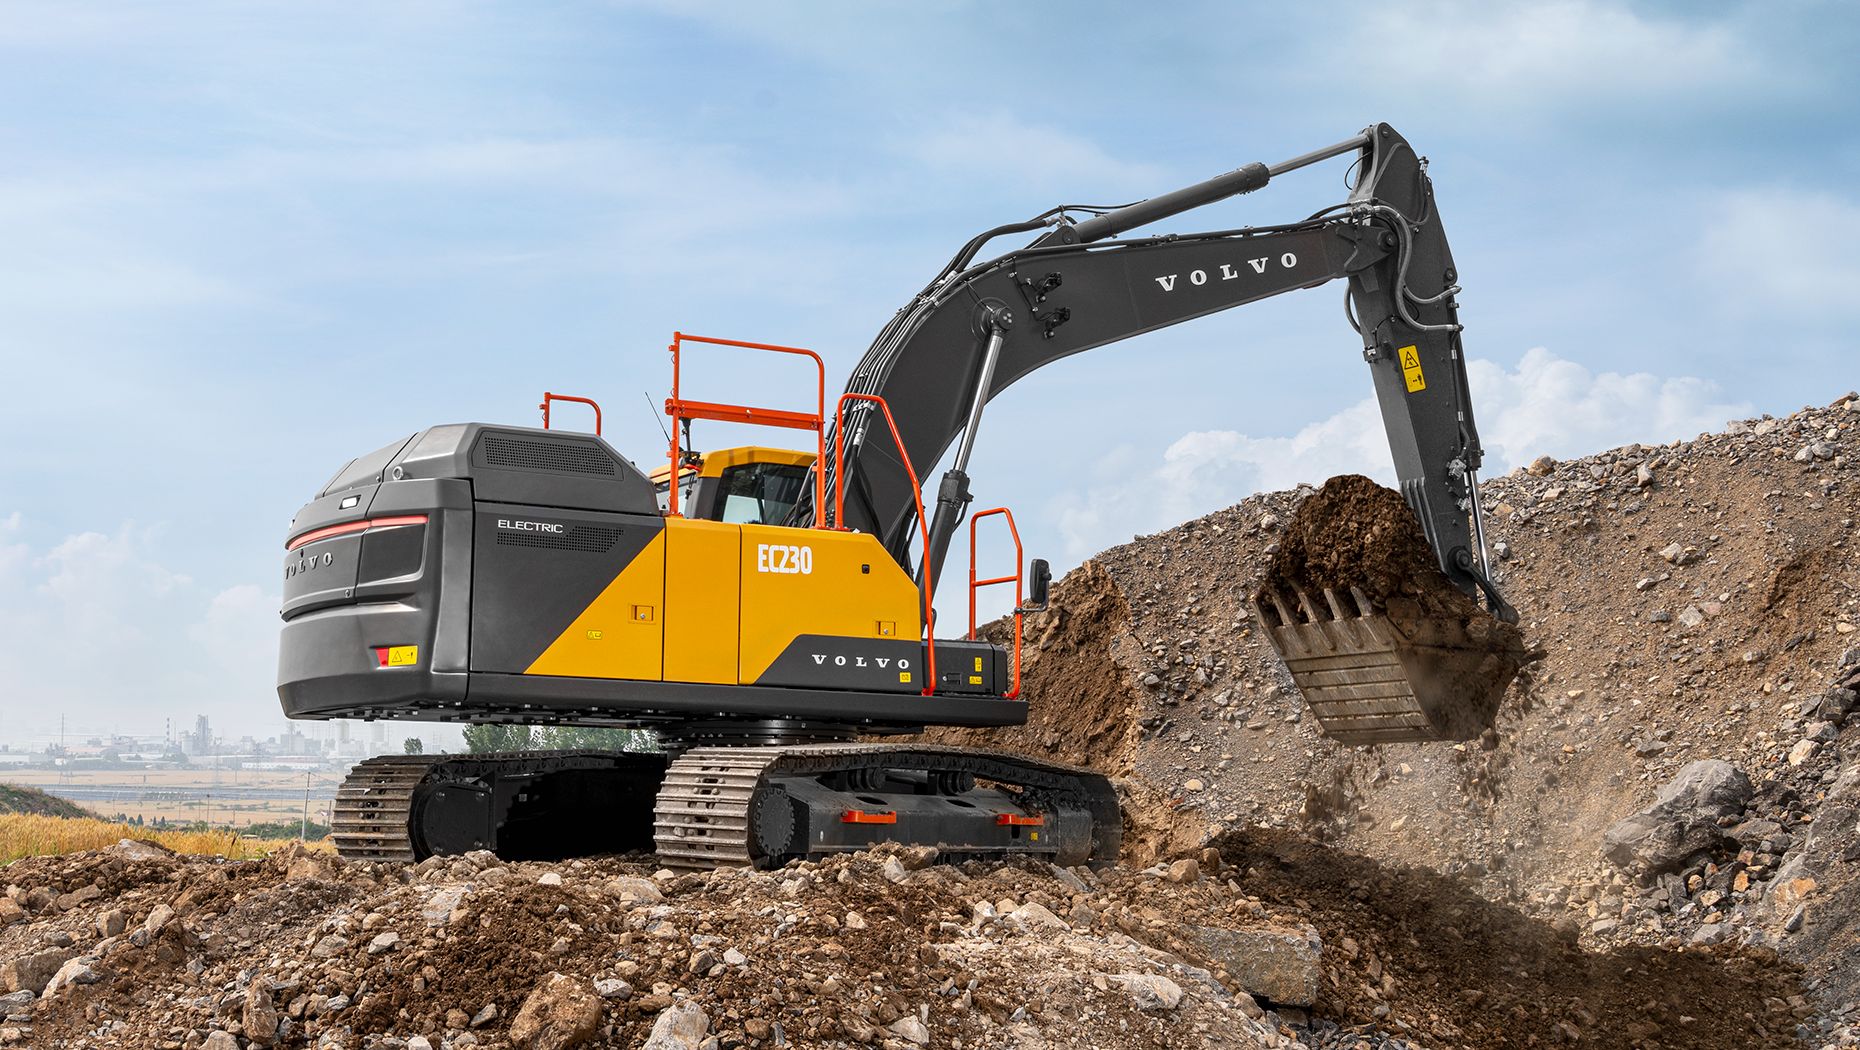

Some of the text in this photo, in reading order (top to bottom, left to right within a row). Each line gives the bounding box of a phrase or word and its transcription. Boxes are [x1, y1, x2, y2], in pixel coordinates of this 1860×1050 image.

[1155, 252, 1298, 292] VOLVO
[497, 519, 564, 534] ELECTRIC
[757, 543, 813, 575] EC230
[811, 654, 910, 670] VOLVO
